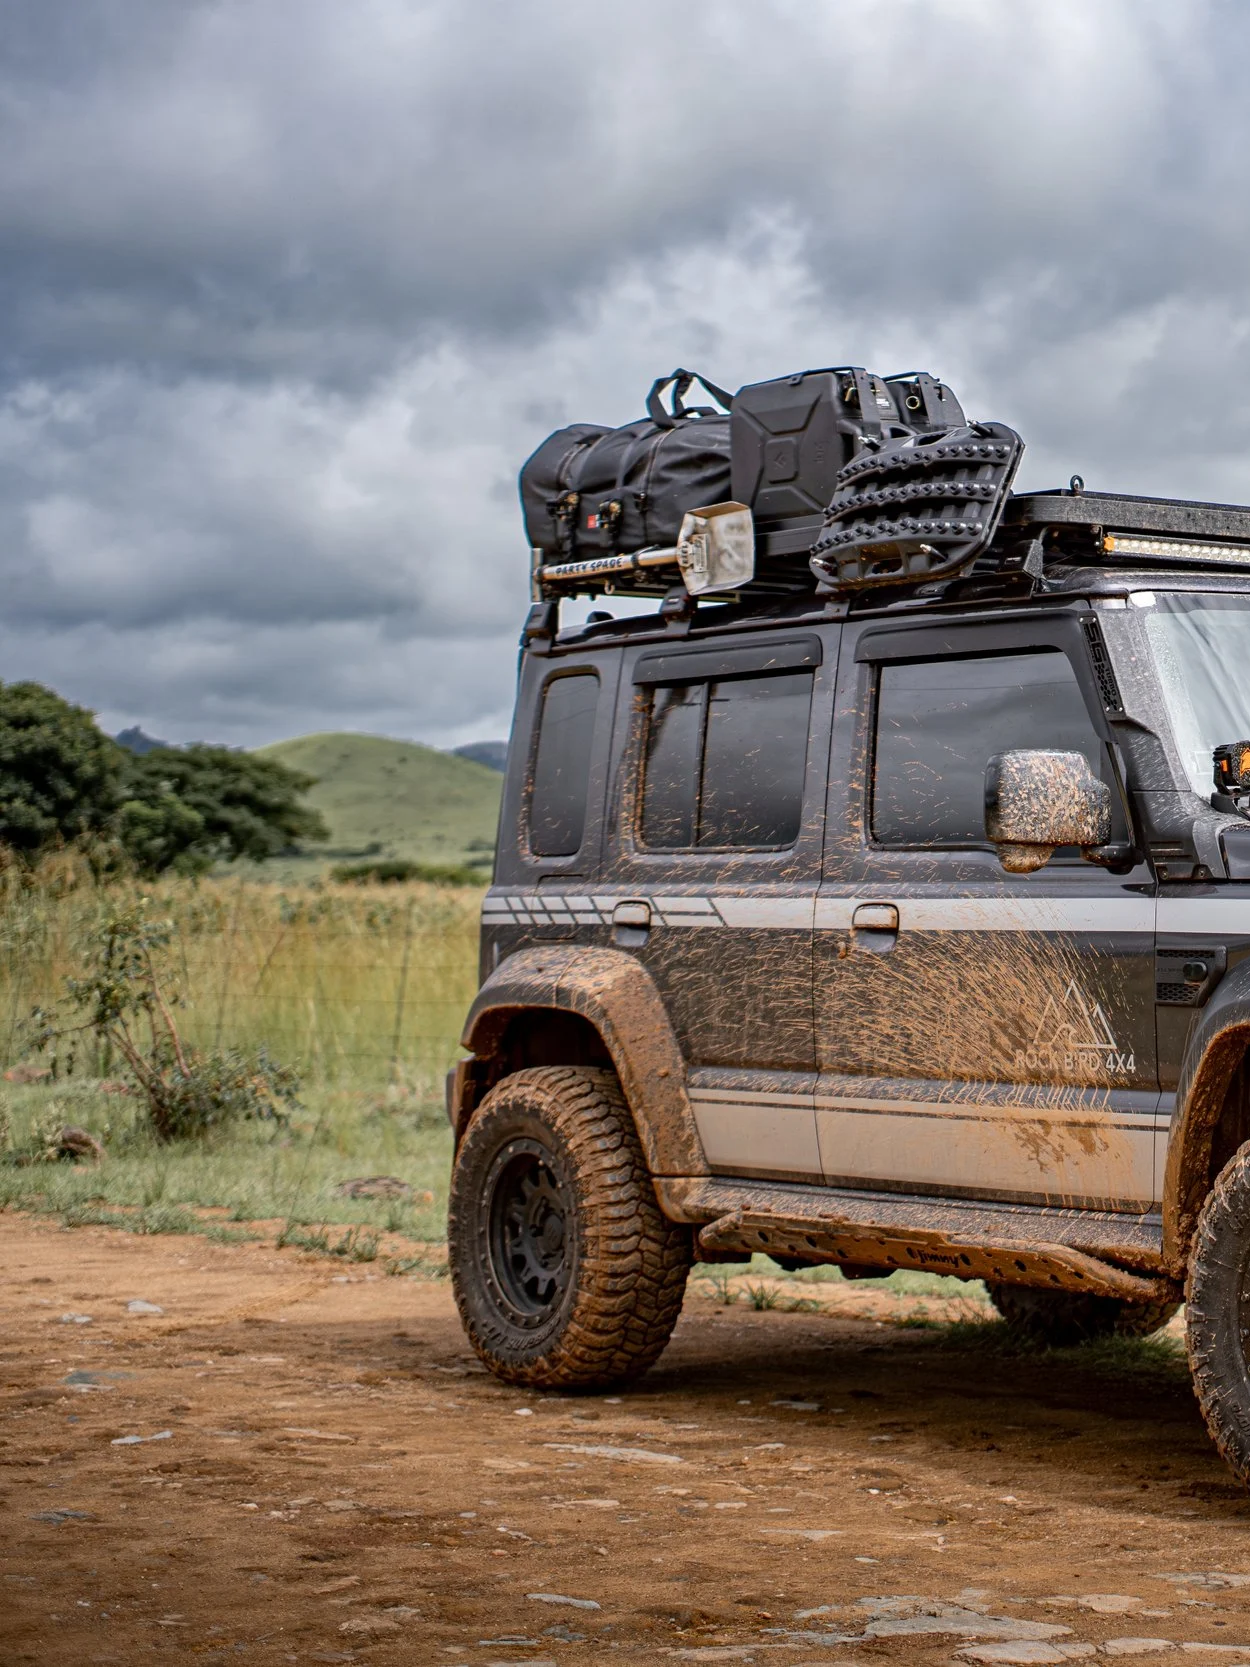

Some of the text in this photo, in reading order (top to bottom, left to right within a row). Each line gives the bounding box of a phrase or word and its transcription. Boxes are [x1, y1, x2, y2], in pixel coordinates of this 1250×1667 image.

[555, 558, 622, 576] PARTY SPADE
[1105, 667, 1117, 697] TURBO
[1015, 1049, 1059, 1070] ROCK
[1105, 1053, 1136, 1074] 4X4
